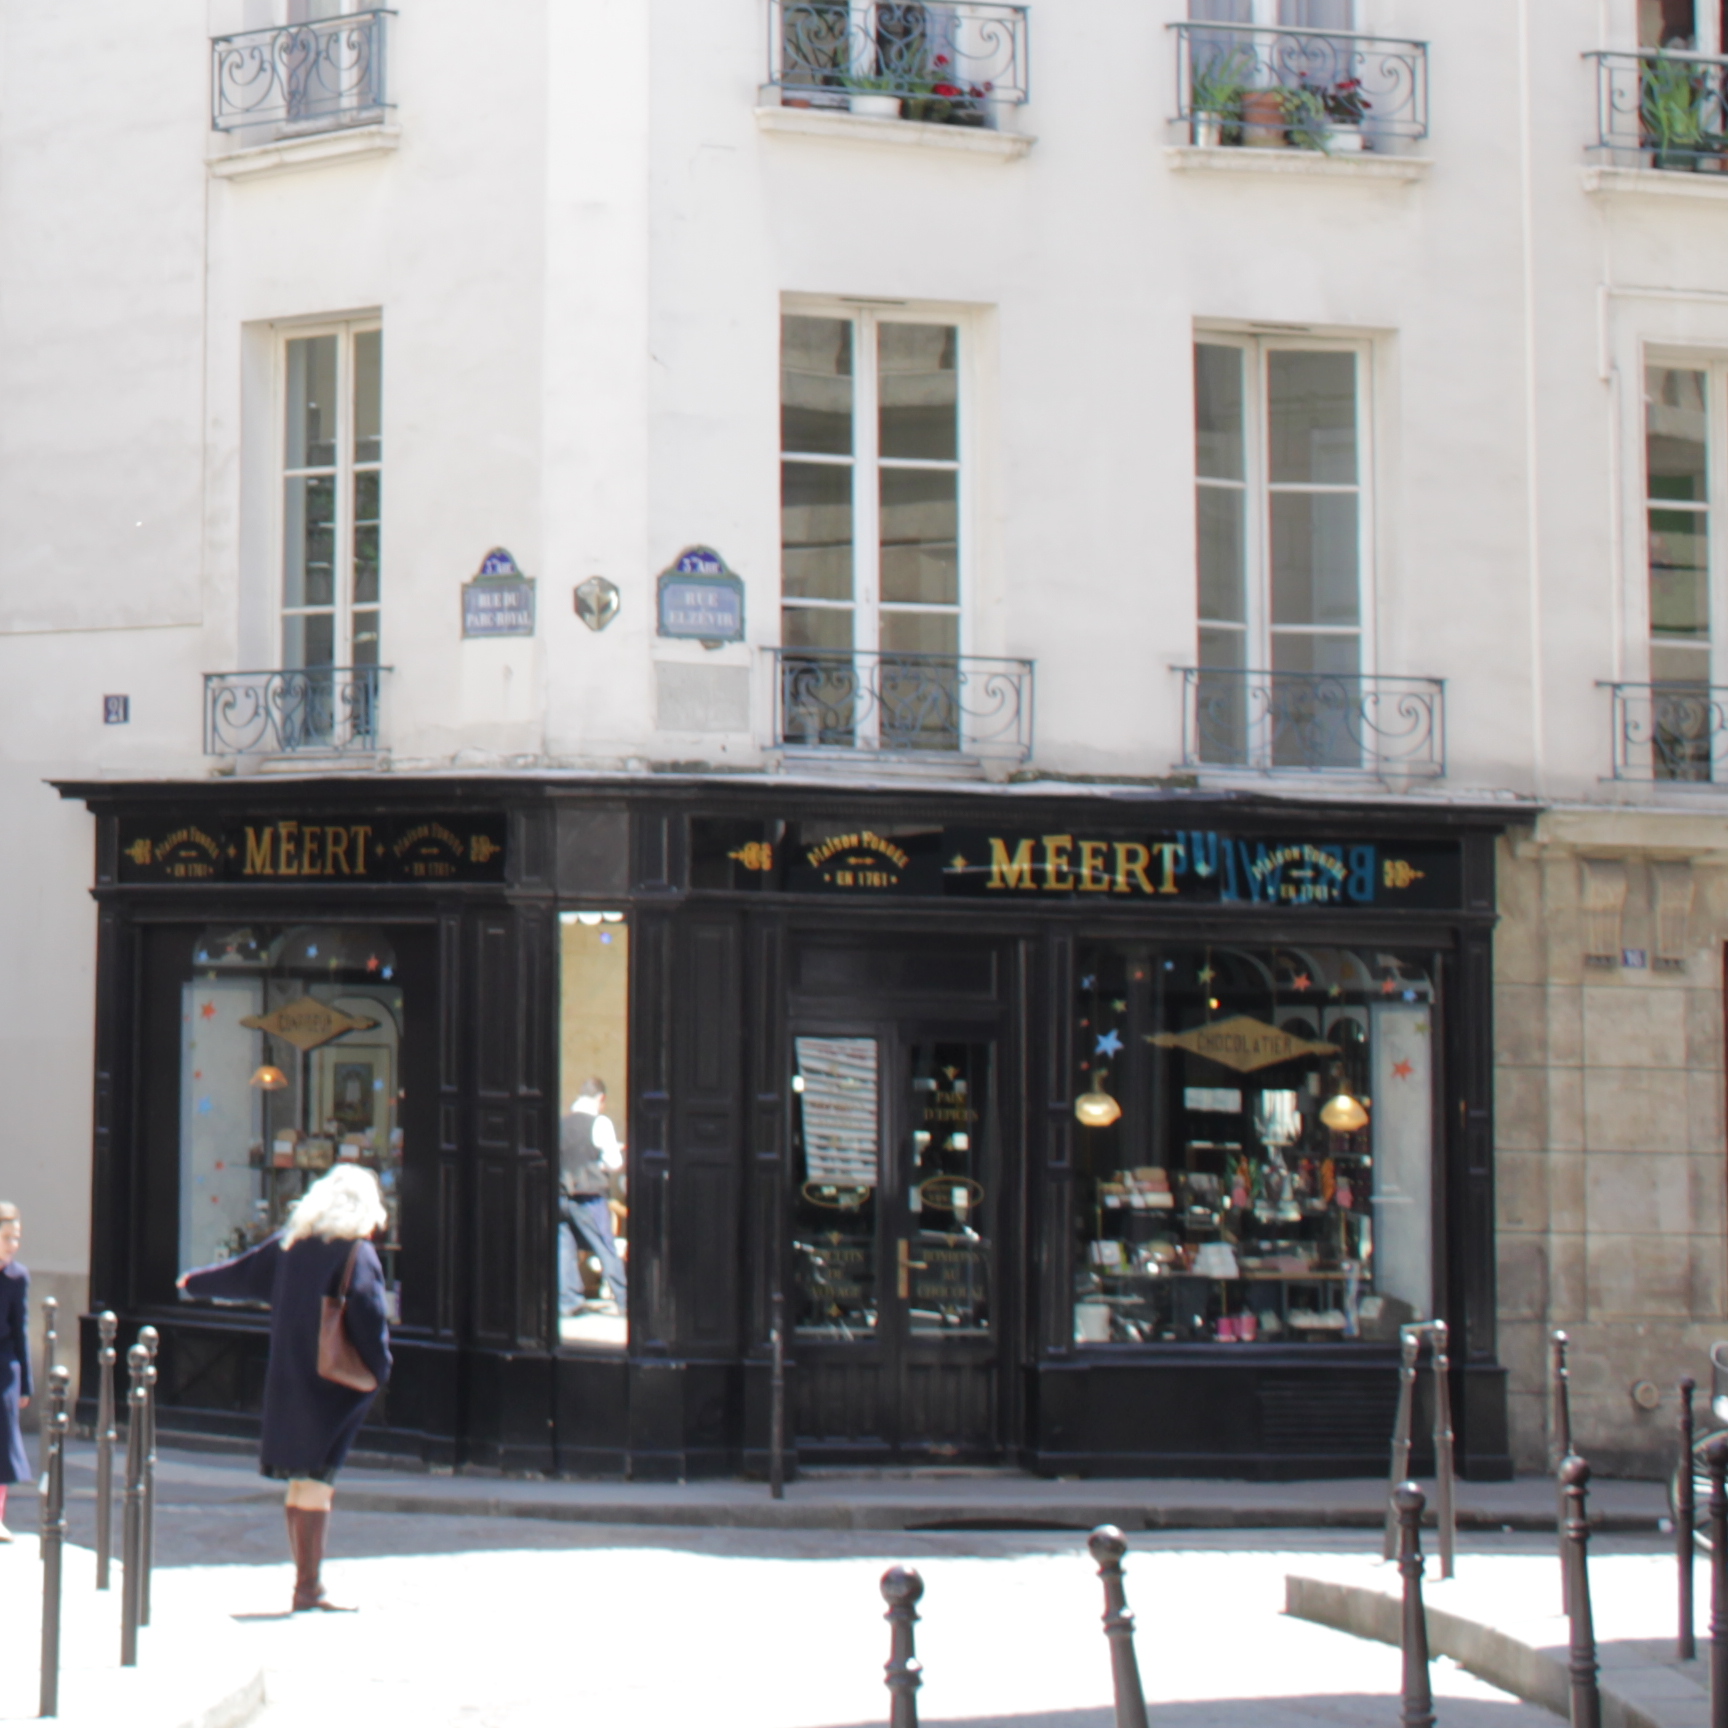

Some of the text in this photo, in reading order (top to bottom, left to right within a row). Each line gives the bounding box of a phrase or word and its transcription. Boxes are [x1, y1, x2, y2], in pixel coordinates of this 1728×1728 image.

[478, 592, 502, 608] RUE
[685, 591, 718, 608] RUE
[858, 871, 889, 887] 1761
[1196, 1031, 1292, 1056] CHOCOLATIER
